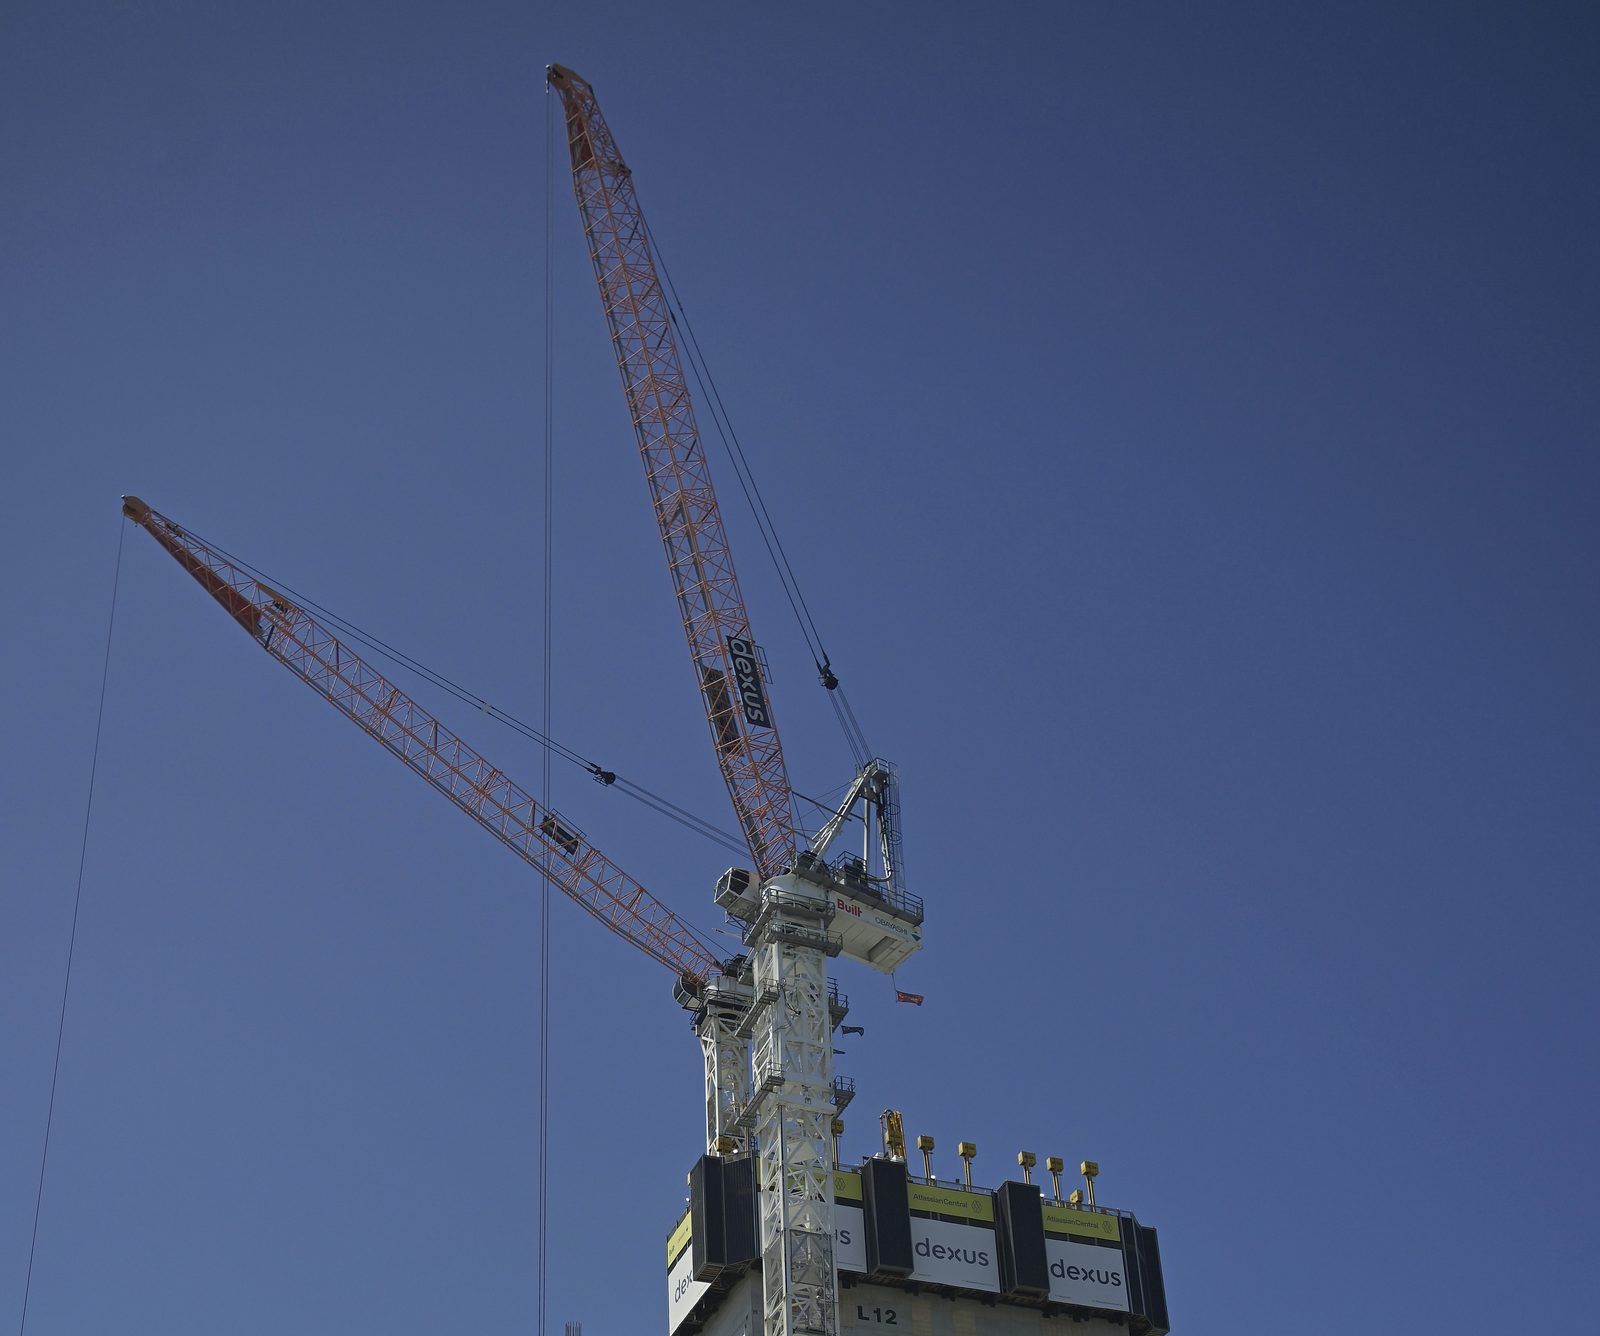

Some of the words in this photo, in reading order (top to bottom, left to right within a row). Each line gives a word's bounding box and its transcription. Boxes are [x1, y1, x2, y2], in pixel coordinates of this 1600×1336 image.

[730, 638, 765, 722] dexus
[837, 898, 863, 918] Built
[914, 1237, 990, 1267] dexus
[1050, 1258, 1122, 1287] dexus
[857, 1305, 897, 1325] L12
